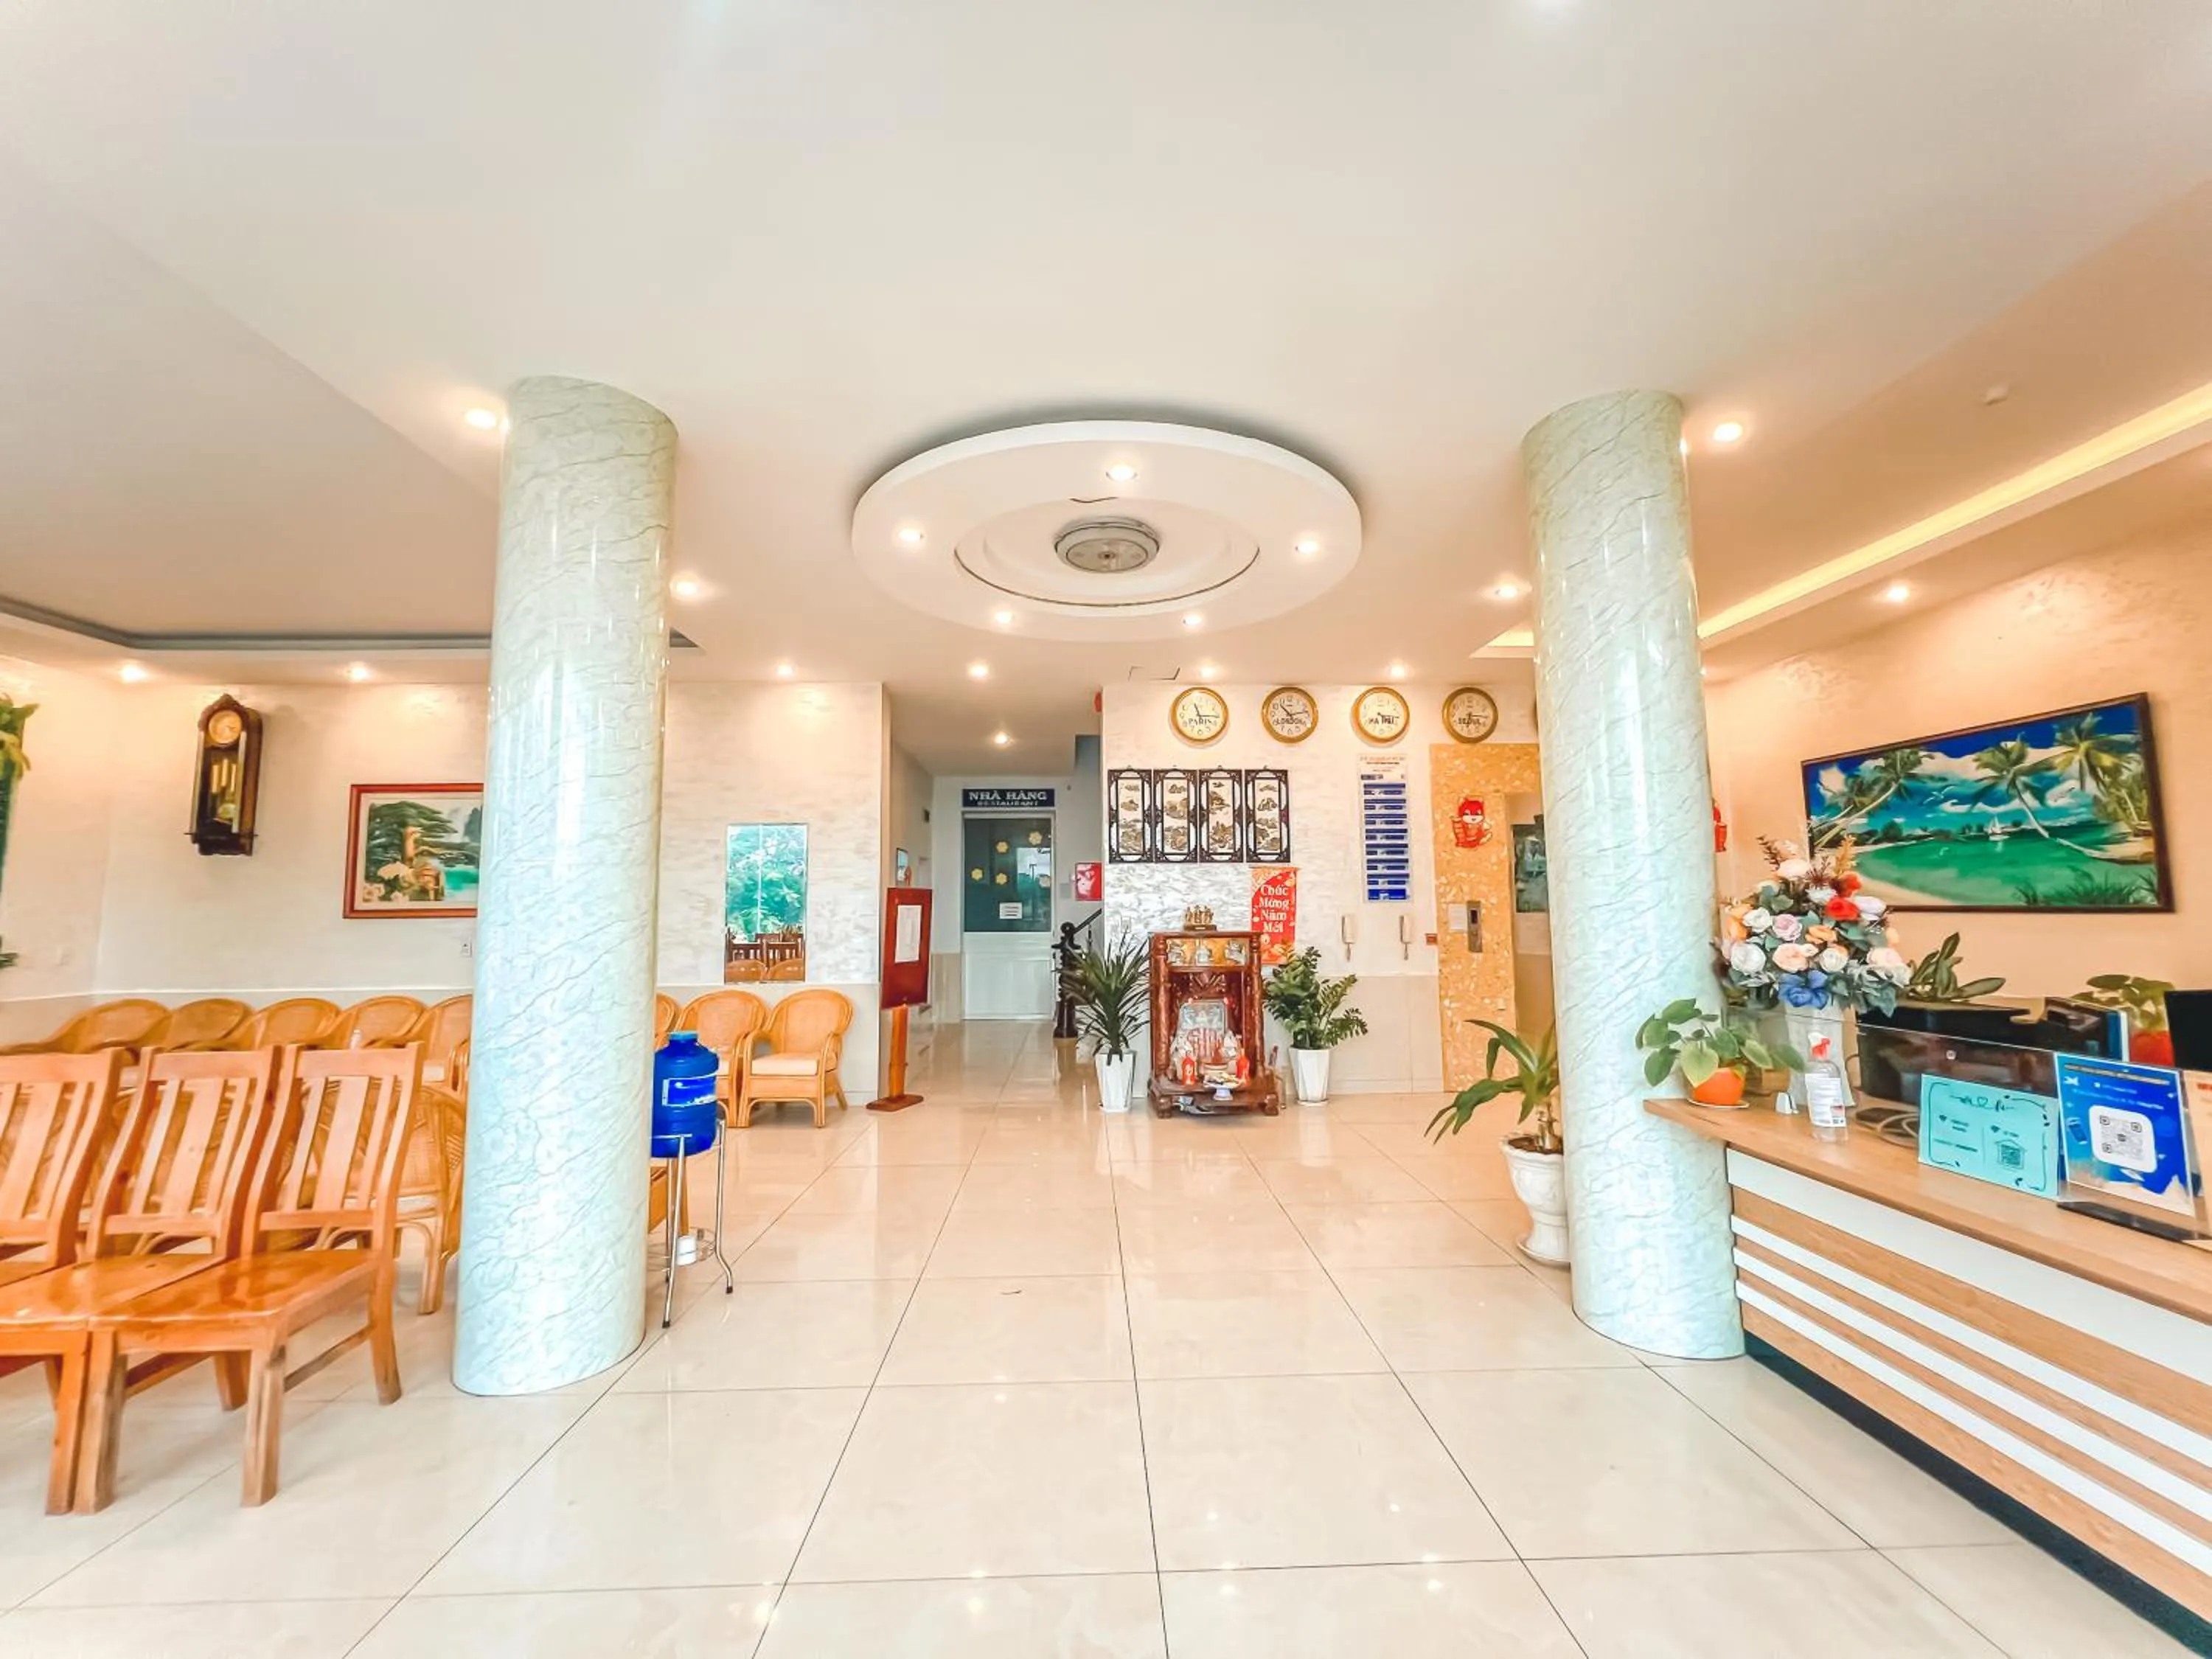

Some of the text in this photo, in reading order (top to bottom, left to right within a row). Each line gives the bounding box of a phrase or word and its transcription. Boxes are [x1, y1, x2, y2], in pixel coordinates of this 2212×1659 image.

[969, 790, 1047, 800] NHÀ HÀNG
[1260, 884, 1289, 896] Chúc
[1261, 909, 1287, 921] Năm
[1262, 921, 1284, 933] Mới
